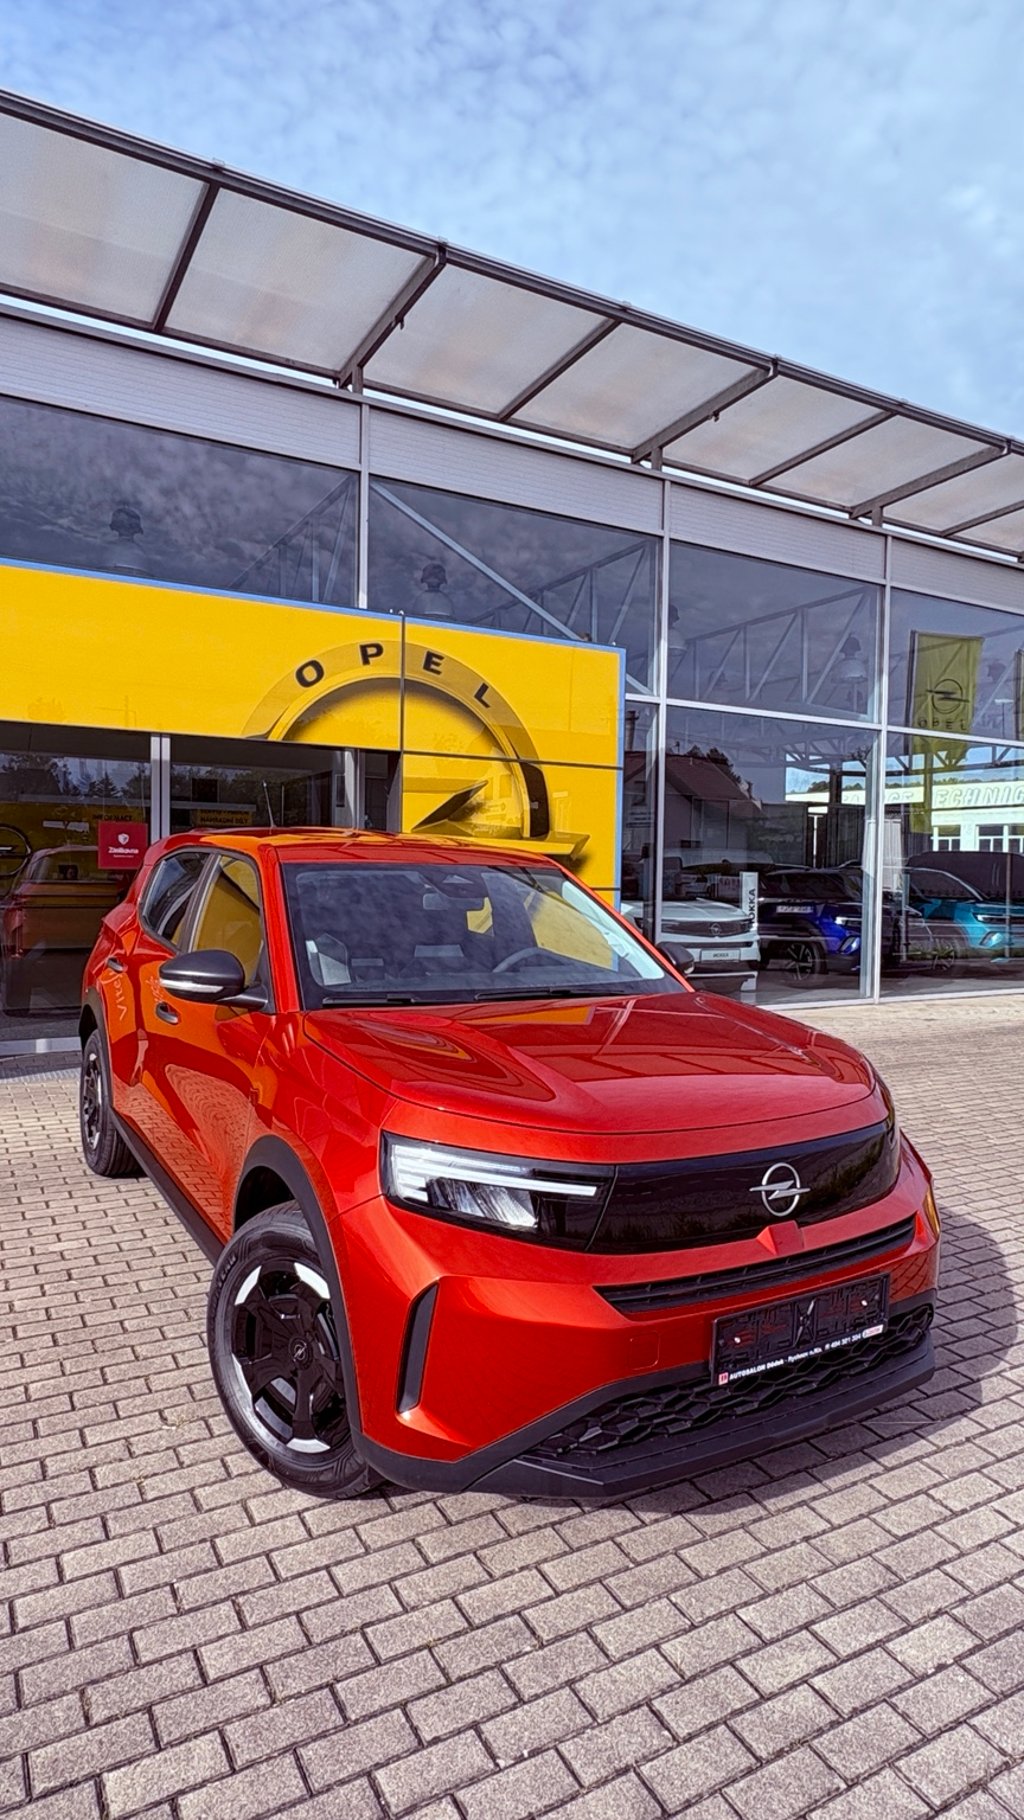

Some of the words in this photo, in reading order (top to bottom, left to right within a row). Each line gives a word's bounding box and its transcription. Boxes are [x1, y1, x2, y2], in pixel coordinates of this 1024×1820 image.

[295, 642, 493, 709] OPEL
[917, 718, 967, 731] OPEL
[729, 1364, 766, 1380] AUTOSALON
